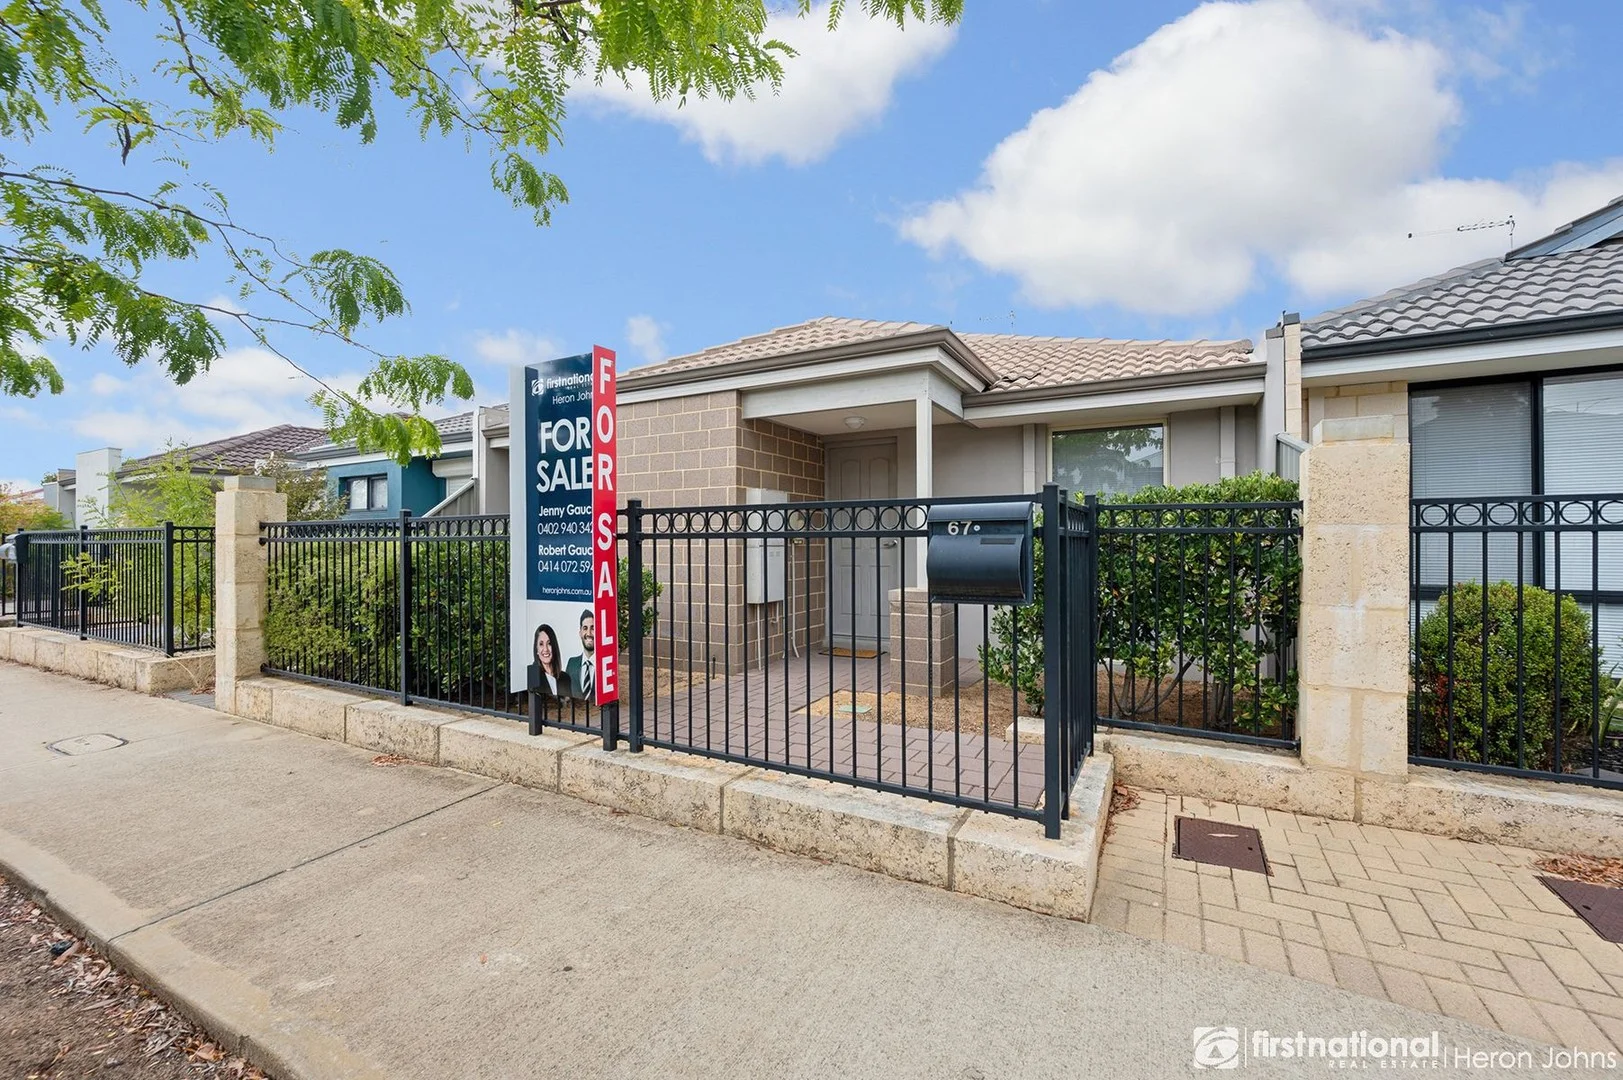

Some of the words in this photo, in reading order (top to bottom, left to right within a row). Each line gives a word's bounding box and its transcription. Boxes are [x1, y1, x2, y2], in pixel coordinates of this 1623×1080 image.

[552, 394, 575, 405] Heron
[577, 390, 593, 402] Joh
[540, 417, 591, 454] FOR
[536, 455, 593, 493] SALE
[538, 505, 565, 519] Jenny
[537, 522, 559, 535] 0402
[560, 521, 578, 535] 940
[947, 521, 973, 536] 67
[538, 544, 567, 556] Robert
[537, 560, 560, 573] 0414
[560, 560, 578, 573] 072
